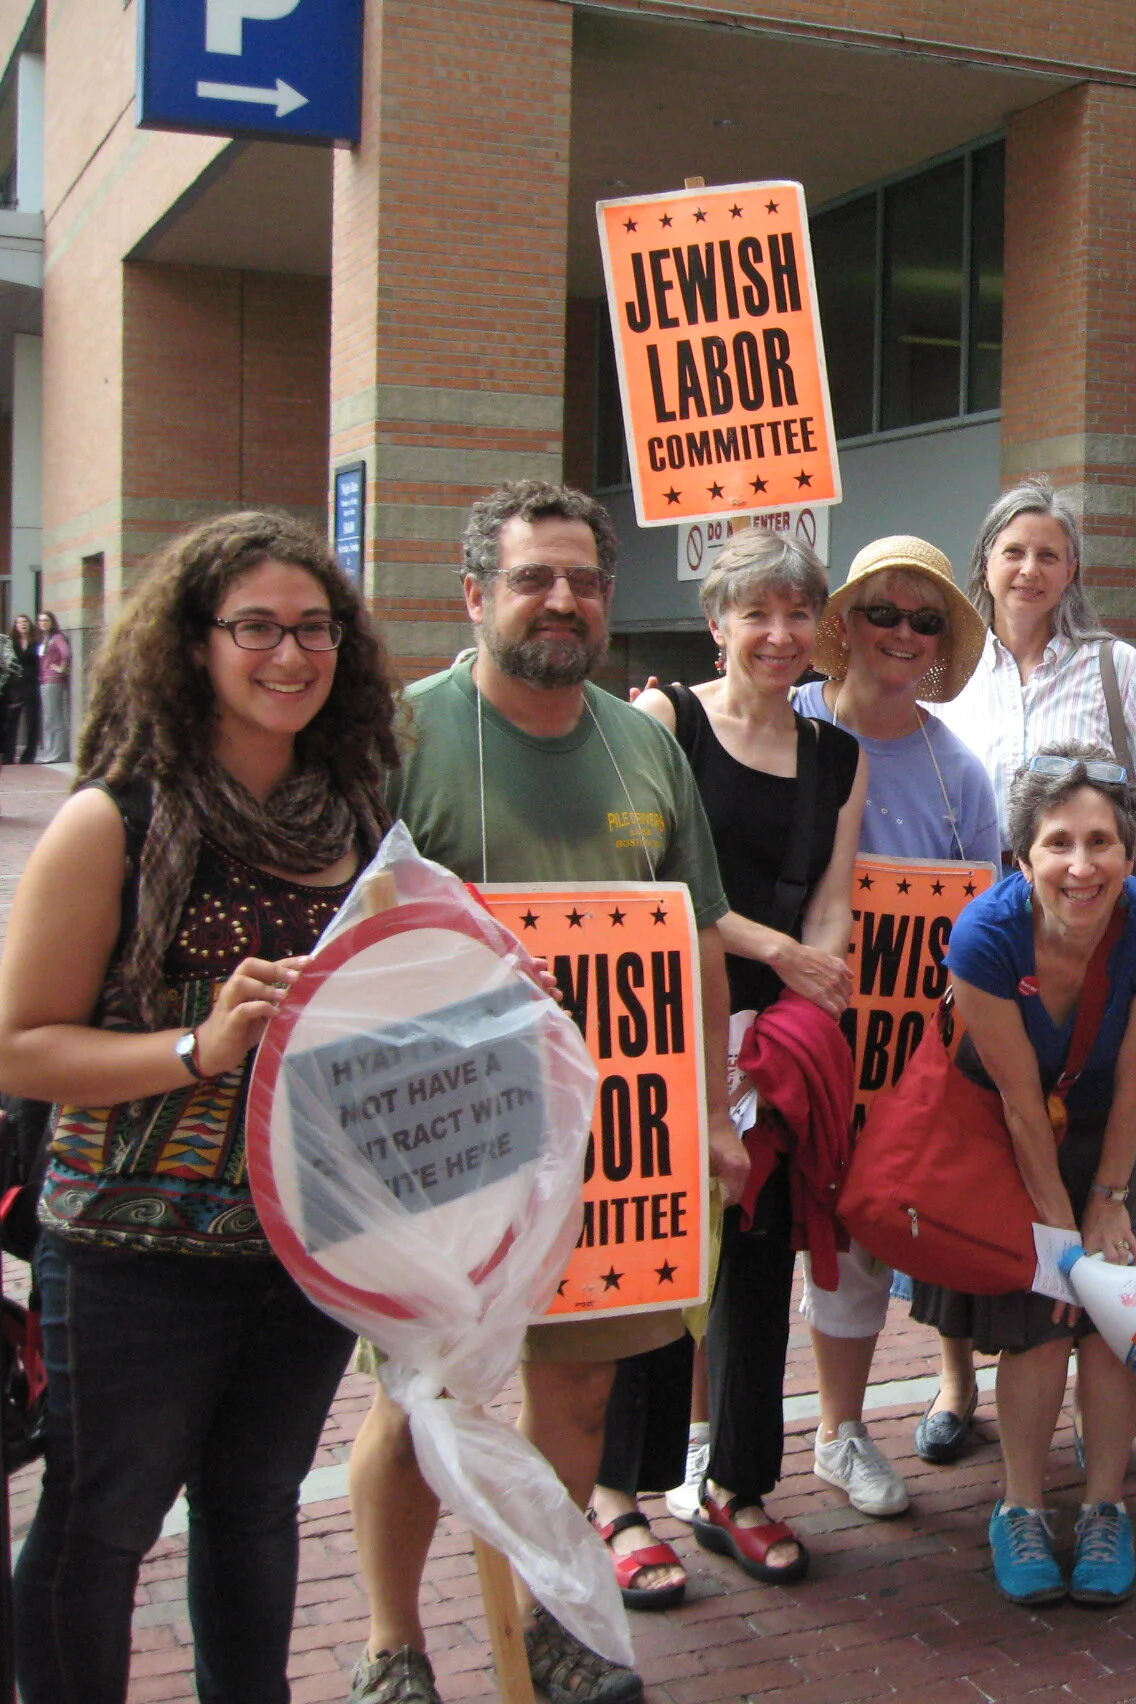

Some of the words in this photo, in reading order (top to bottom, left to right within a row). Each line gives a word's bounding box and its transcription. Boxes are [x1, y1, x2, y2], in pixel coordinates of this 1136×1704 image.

[625, 232, 801, 333] JEWISH
[646, 328, 798, 423] LABOR
[647, 417, 817, 472] COMMITTEE
[707, 522, 722, 541] DO
[753, 512, 790, 532] ENTER
[407, 1059, 477, 1105] HAVE
[485, 1051, 502, 1077] A
